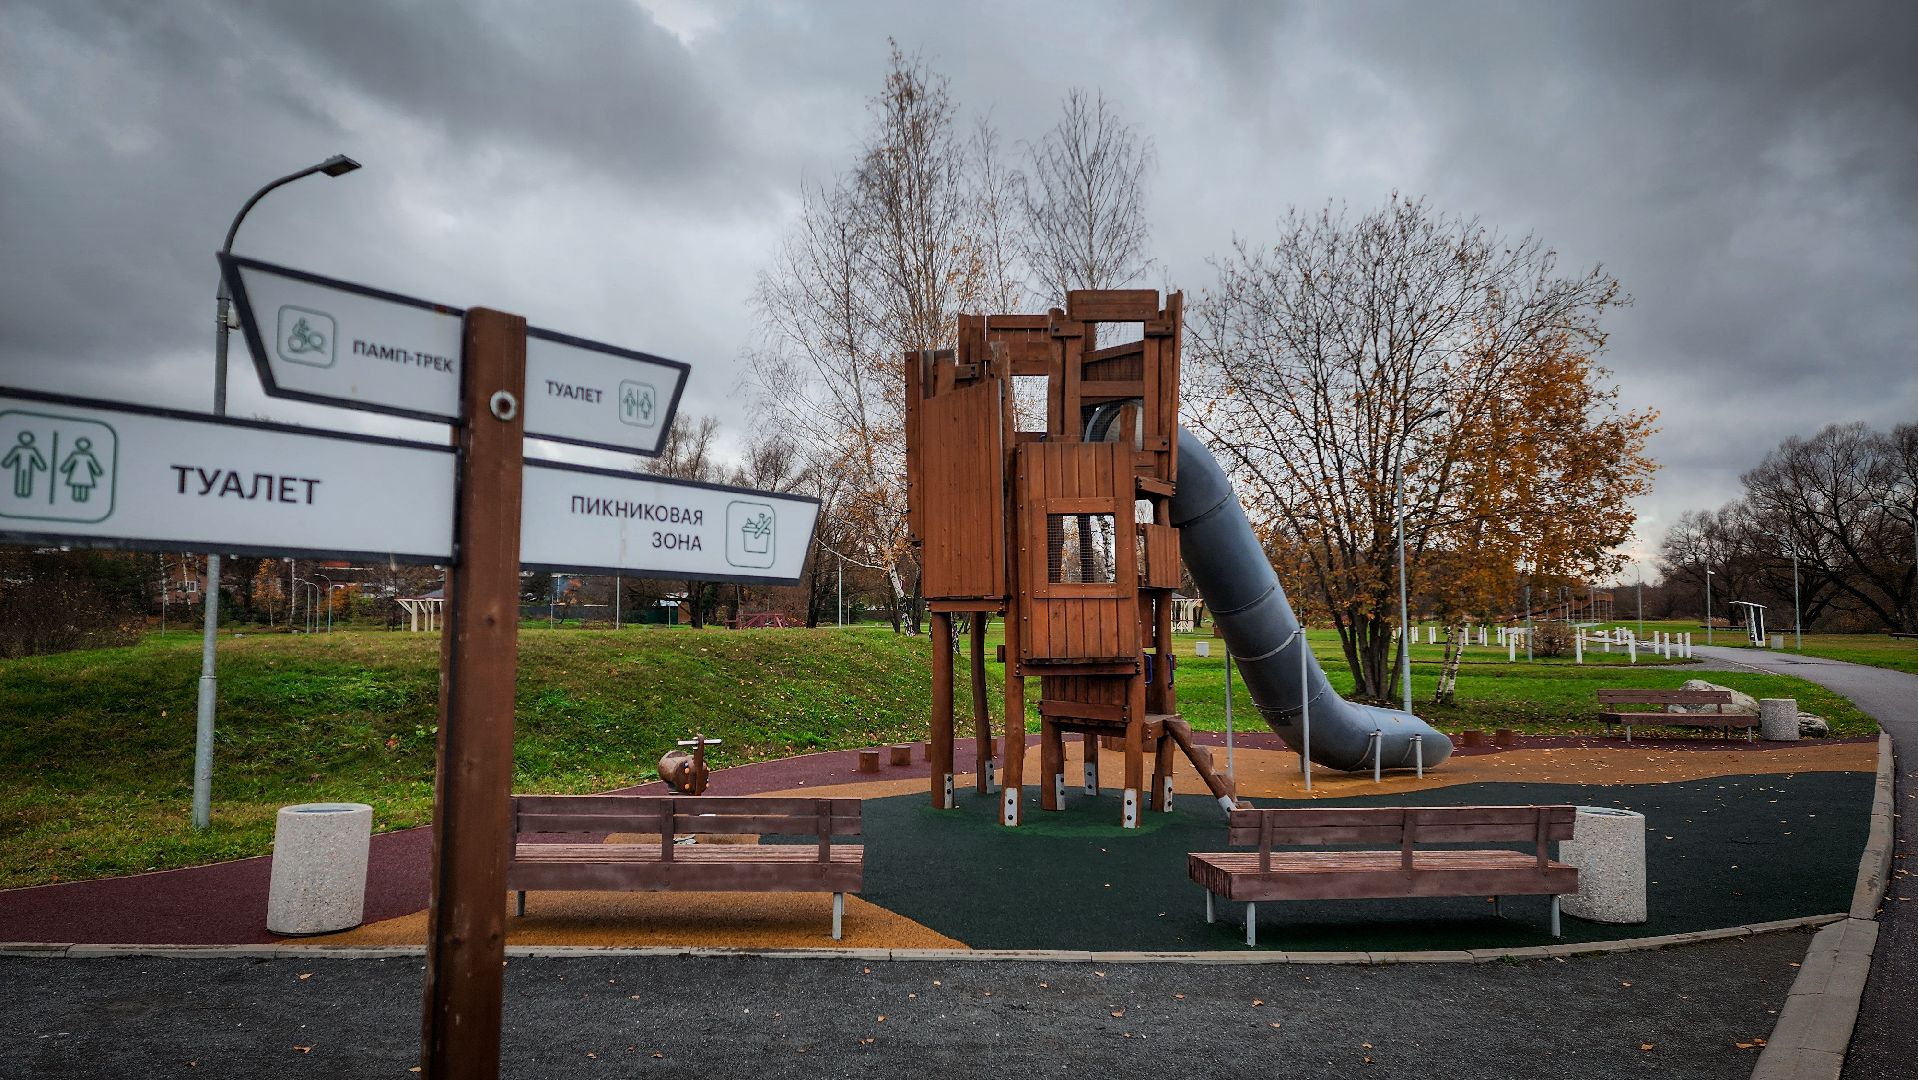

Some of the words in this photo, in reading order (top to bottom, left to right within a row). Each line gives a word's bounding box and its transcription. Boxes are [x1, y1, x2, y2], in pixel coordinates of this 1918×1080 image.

[352, 339, 453, 373] ПАМП-ТРЕК
[545, 379, 603, 404] ТУАЛЕТ
[170, 465, 321, 505] ТУАЛЕТ
[570, 495, 703, 527] ПИКНИКОВАЯ
[651, 532, 702, 552] ЗОНА
